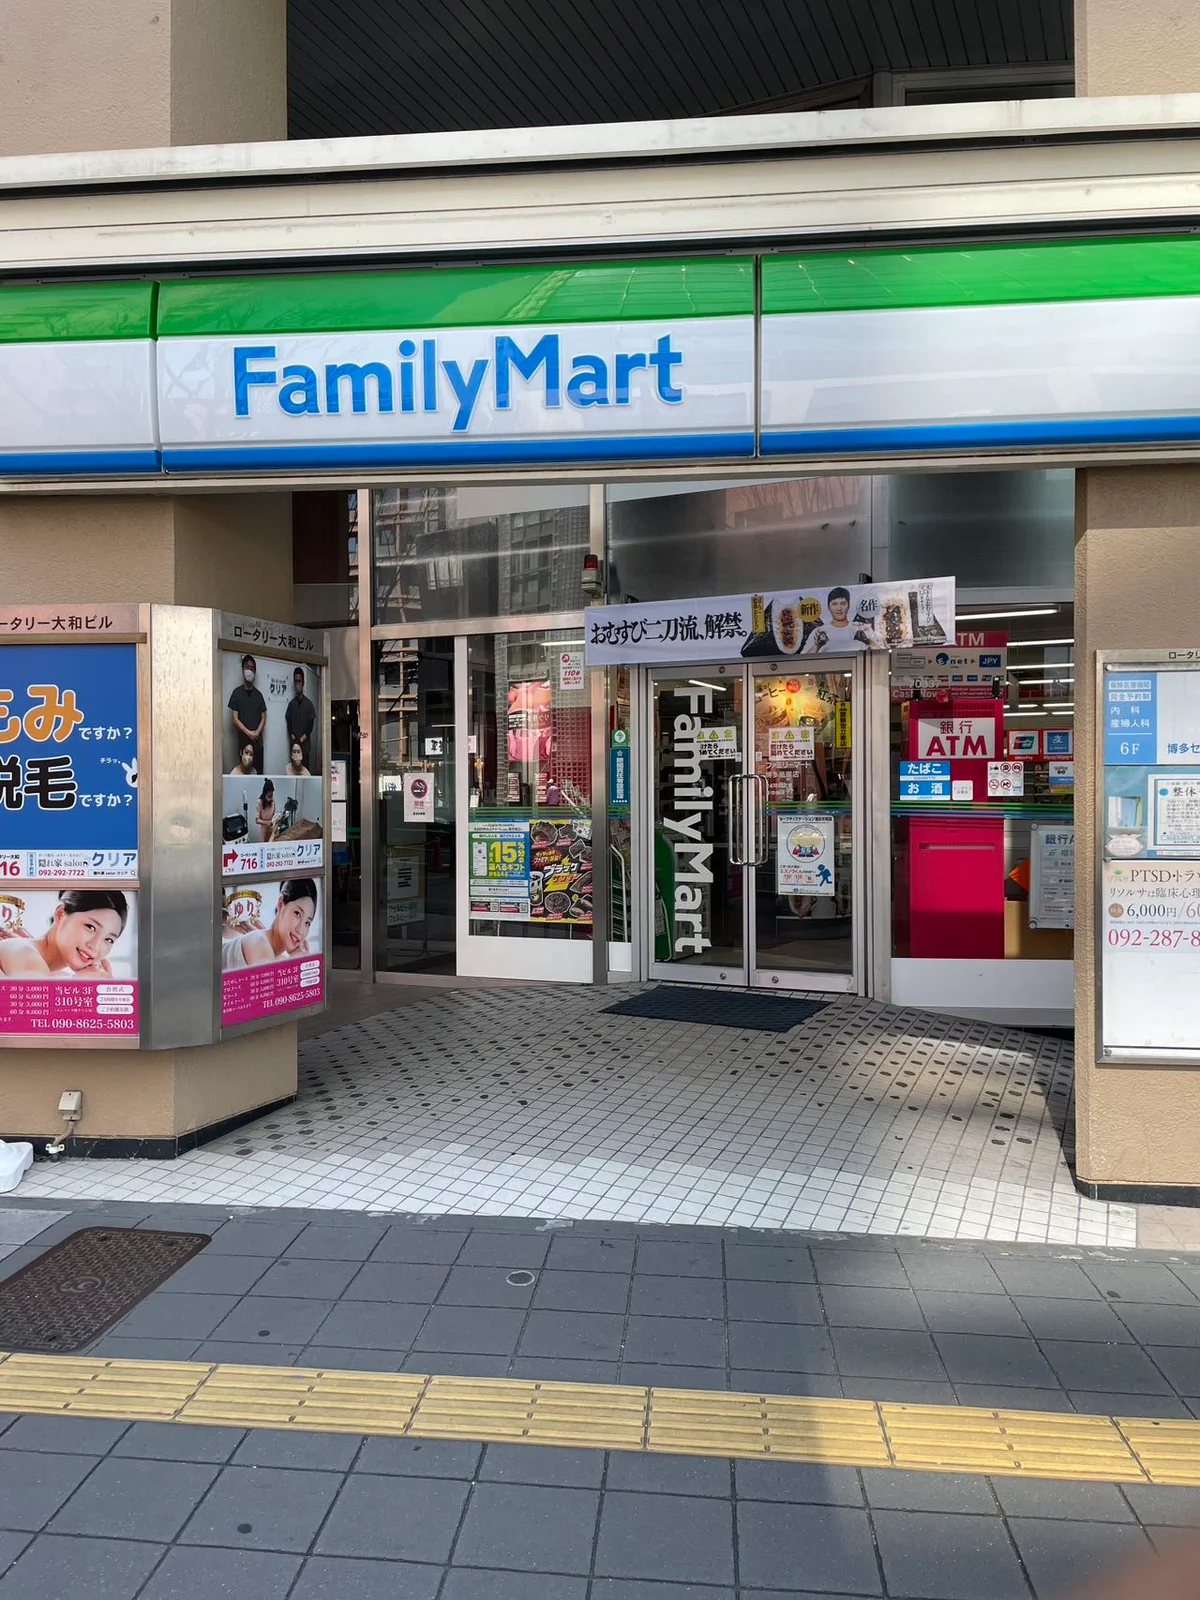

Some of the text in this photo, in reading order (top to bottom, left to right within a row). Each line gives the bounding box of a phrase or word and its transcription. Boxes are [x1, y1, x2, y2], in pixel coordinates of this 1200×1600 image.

[232, 332, 684, 432] FamilyMart
[799, 602, 819, 616] 新作
[858, 597, 878, 612] 名作
[589, 612, 748, 647] おむすび二刀流、解禁。
[233, 626, 314, 651] ロータリー大和ビル
[954, 632, 985, 646] TM
[982, 657, 998, 665] JPY
[269, 683, 287, 696] クリア
[1111, 705, 1140, 715] 内科
[940, 720, 973, 734] 銀行
[1111, 719, 1150, 728] 産婦人科
[926, 735, 988, 756] ATM
[1120, 742, 1140, 755] 6F
[767, 761, 811, 769] ファミリーマート
[908, 763, 942, 774] たばこ
[908, 783, 943, 794] お酒
[1173, 787, 1197, 797] 整体
[663, 687, 714, 954] FamilyMart
[296, 844, 321, 857] クリア
[490, 841, 518, 863] 15
[38, 858, 62, 868] 隠れ家
[91, 852, 137, 867] クリア
[240, 858, 258, 870] 716
[2, 905, 12, 922] り
[234, 900, 255, 918] ゆり
[276, 974, 299, 987] 310号室
[54, 985, 93, 996] 当ビル 3F
[54, 996, 94, 1008] 310号室
[262, 1000, 275, 1009] TEL
[274, 987, 320, 1007] 090-8625-5803
[31, 1018, 134, 1029] TEL 090-8625-5803
